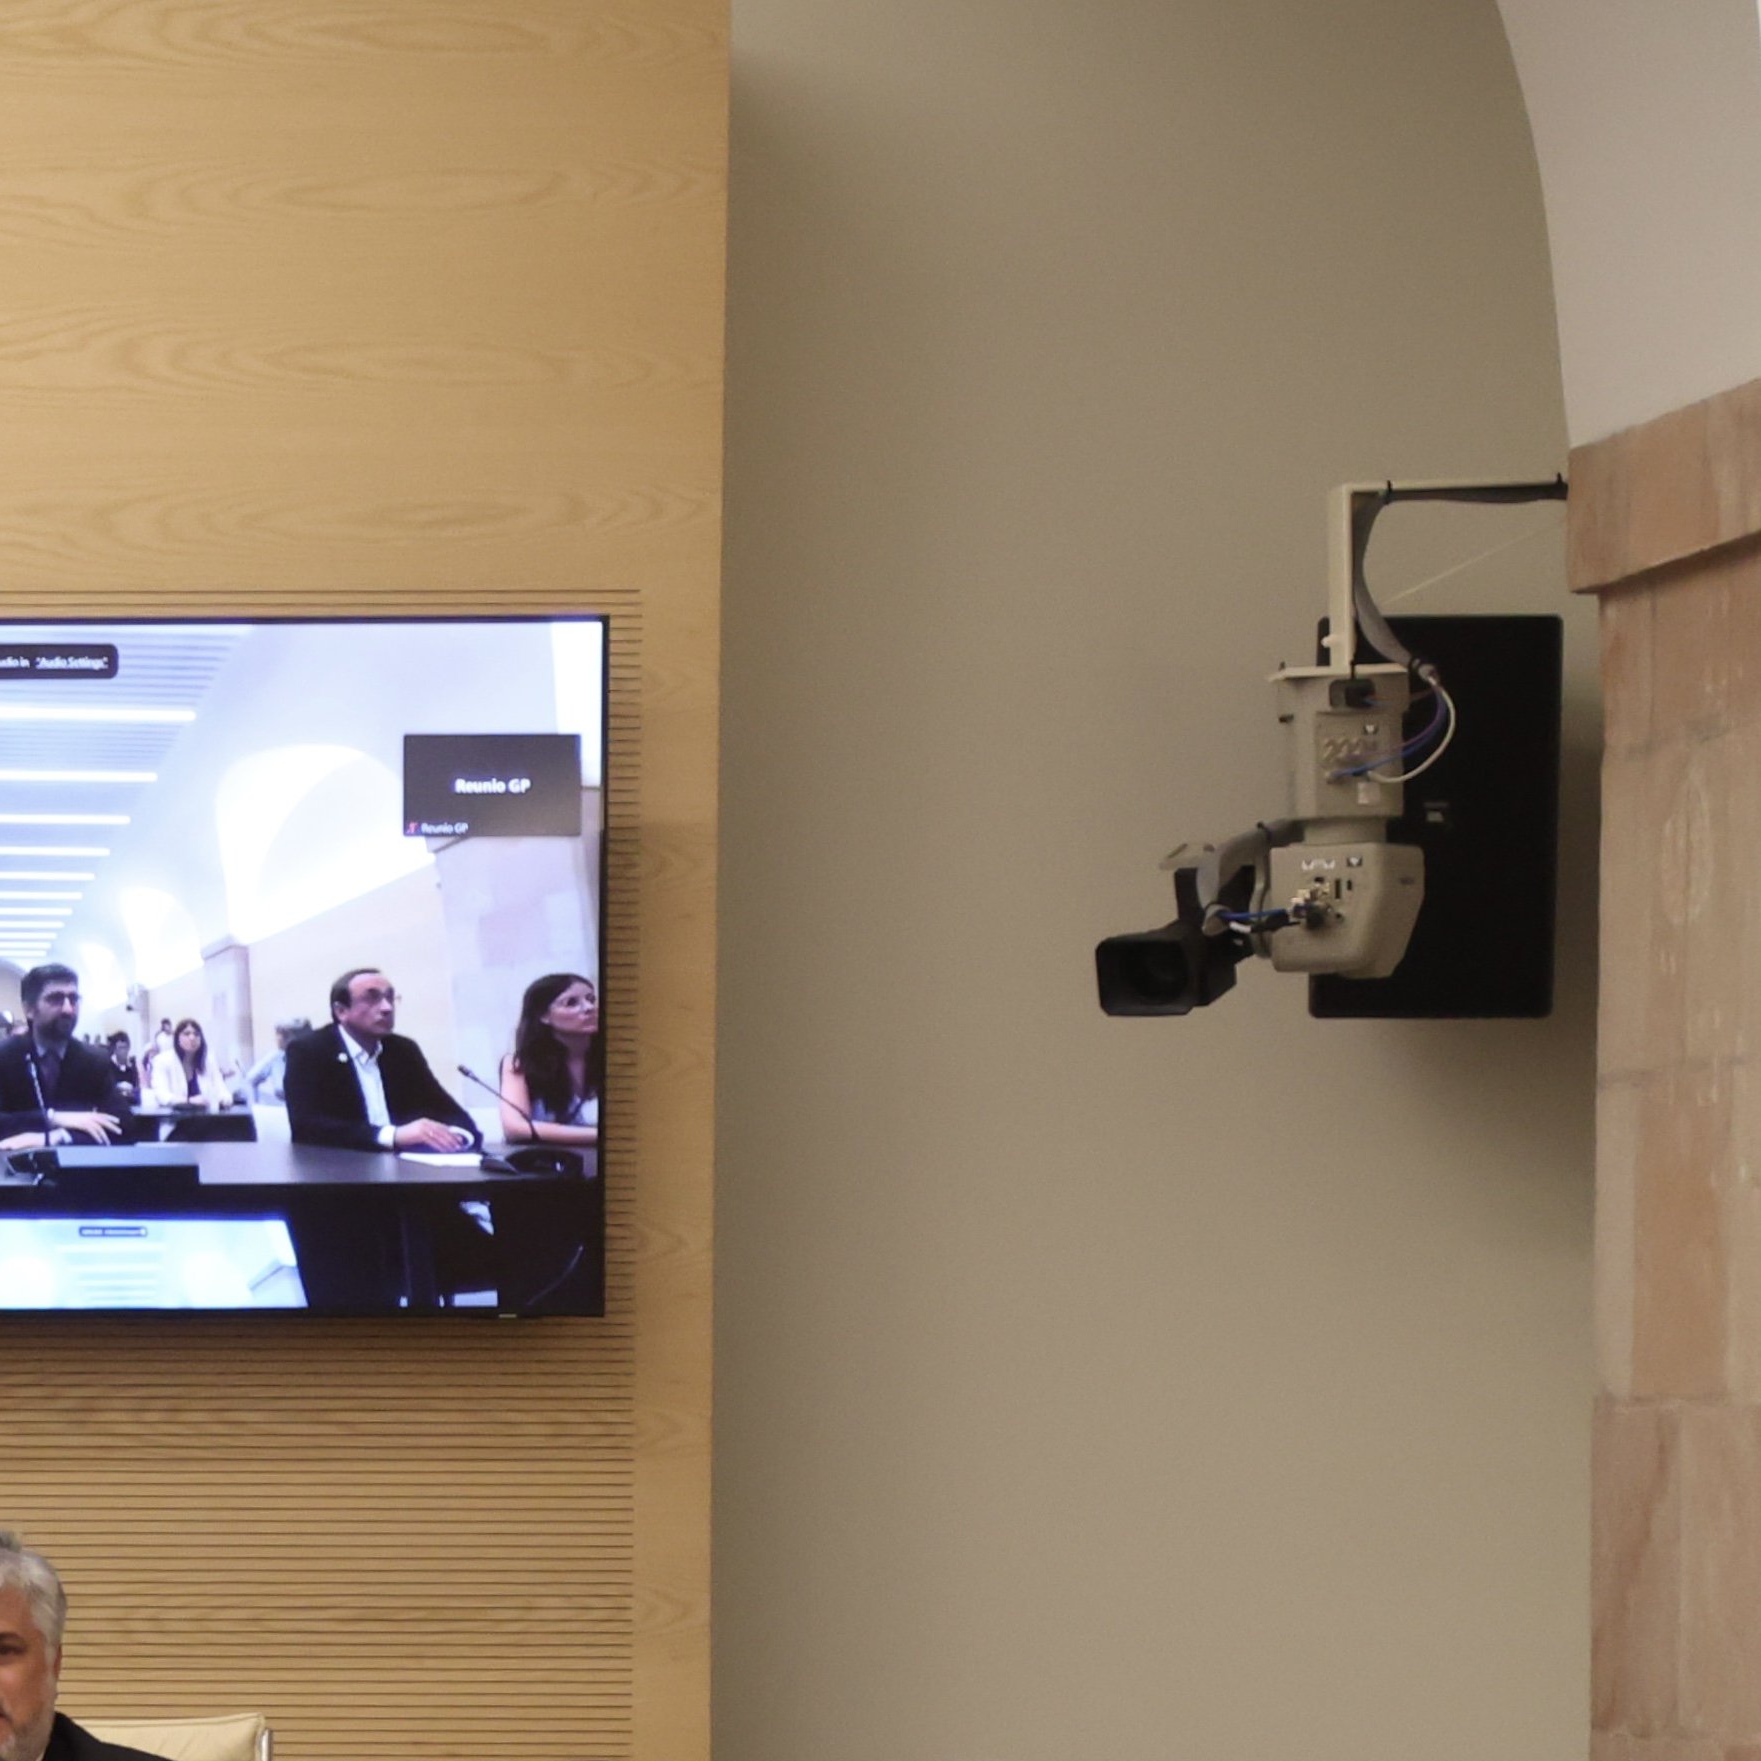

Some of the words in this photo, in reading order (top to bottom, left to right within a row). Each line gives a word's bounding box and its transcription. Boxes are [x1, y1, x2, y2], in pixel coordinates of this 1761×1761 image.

[19, 656, 30, 669] in
[454, 777, 506, 794] Reunio
[507, 777, 531, 794] GP
[420, 821, 454, 834] Reunio
[454, 822, 469, 834] GP
